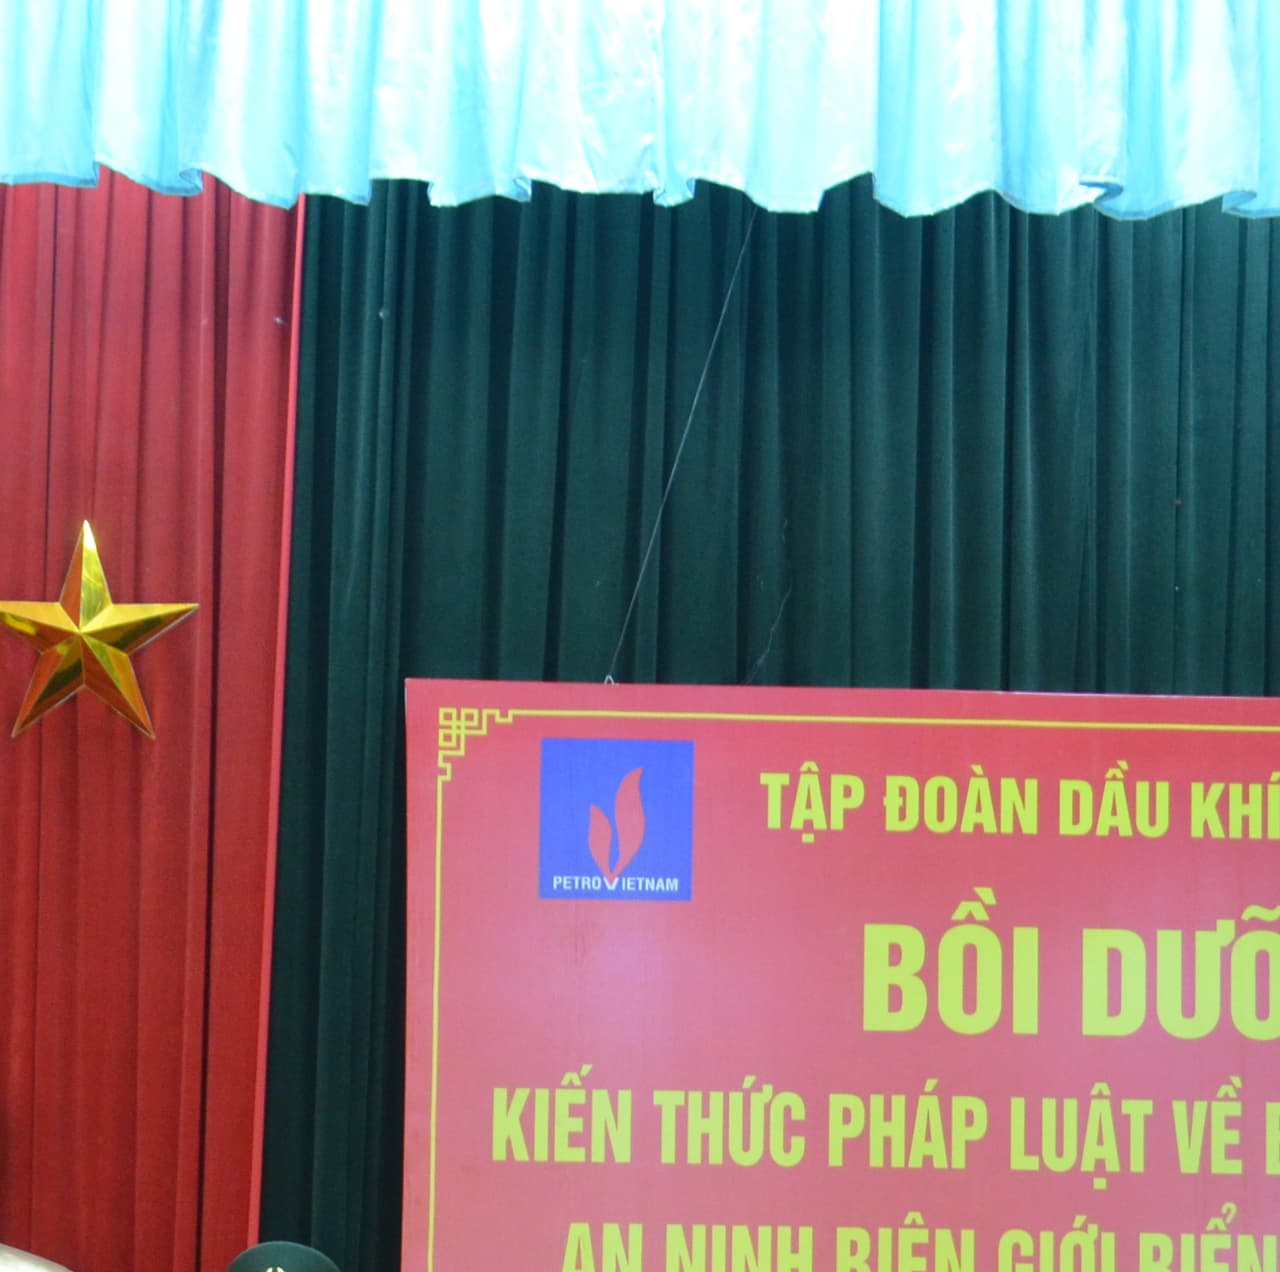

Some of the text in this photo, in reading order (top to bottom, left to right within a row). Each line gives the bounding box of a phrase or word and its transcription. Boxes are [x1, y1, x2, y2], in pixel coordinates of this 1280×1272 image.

[761, 762, 864, 842] TẬP
[884, 765, 1038, 834] ĐOÀN
[1060, 761, 1169, 837] DẦU
[1192, 772, 1280, 839] KHÍ
[552, 875, 680, 892] PETROVIETNAM
[864, 887, 1039, 1034] BỒI
[493, 1066, 632, 1163] KIẾN
[655, 1076, 806, 1167] THỨC
[829, 1079, 988, 1168] PHÁP
[1011, 1083, 1153, 1189] LUẬT
[1173, 1076, 1243, 1174] VỀ
